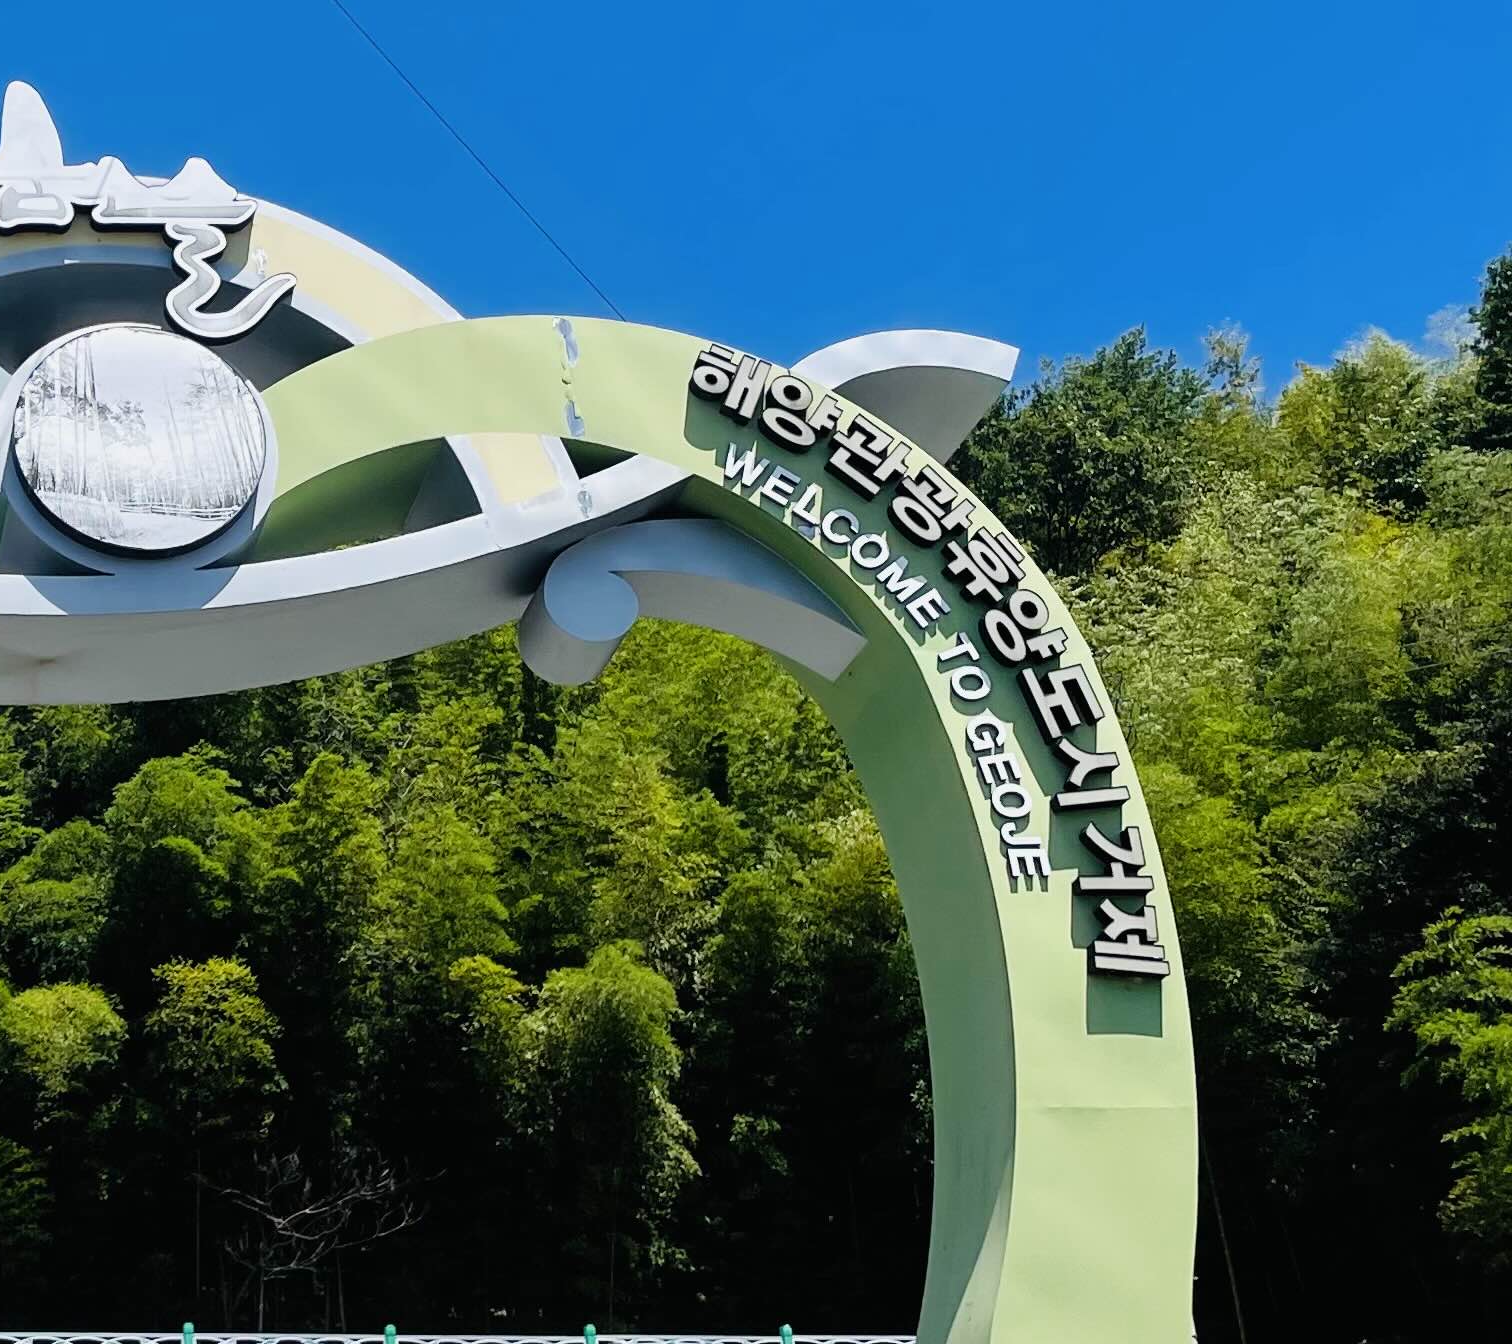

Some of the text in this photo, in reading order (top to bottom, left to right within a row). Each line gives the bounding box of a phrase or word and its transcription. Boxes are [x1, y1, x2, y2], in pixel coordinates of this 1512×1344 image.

[722, 441, 1052, 879] WELCOME TO GEOJE
[1073, 824, 1172, 979] 거제
